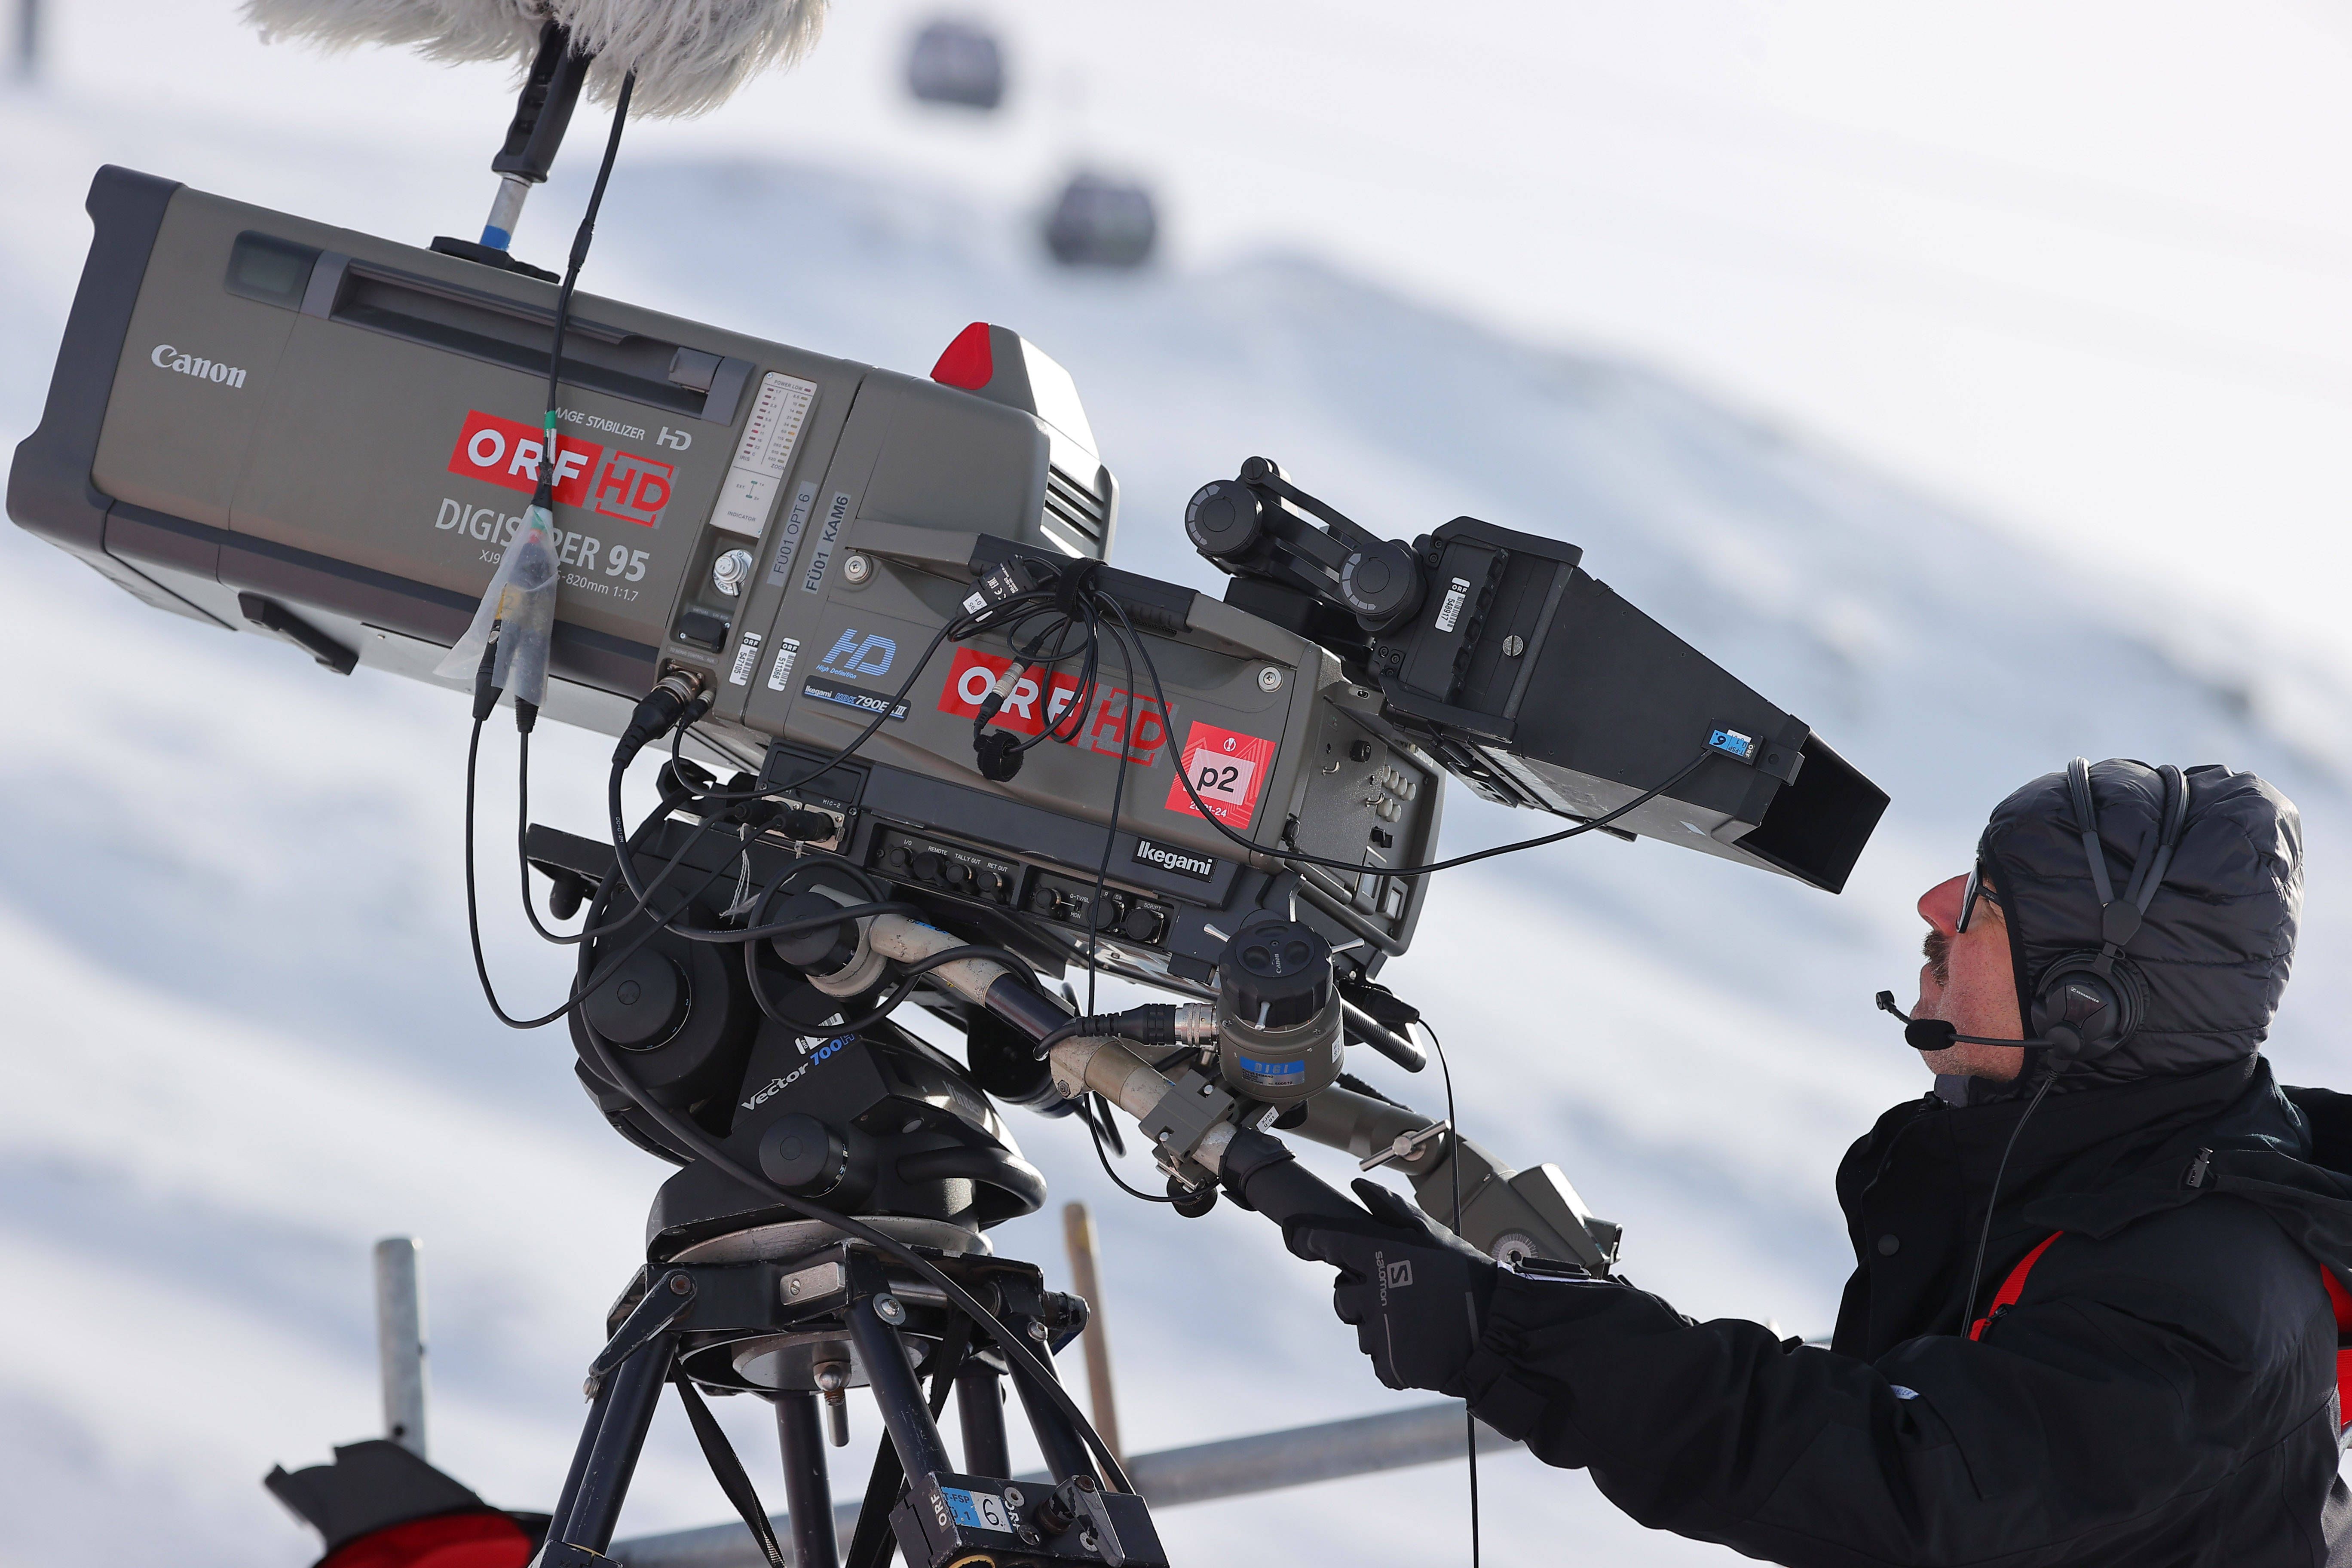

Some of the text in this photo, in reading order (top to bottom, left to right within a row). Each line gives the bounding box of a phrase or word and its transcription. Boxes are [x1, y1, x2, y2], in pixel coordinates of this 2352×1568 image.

[151, 344, 247, 388] Canon
[774, 380, 791, 388] POWER
[544, 407, 692, 451] MAGE STABILIZER HD
[467, 429, 671, 513] ORF HD
[727, 511, 756, 522] INDICATOR
[435, 498, 650, 582] DIGISPER 95
[774, 493, 810, 574] FÜ01 OPT 6
[806, 496, 848, 591] FÜ01 KAM6
[479, 549, 501, 565] XJ9
[613, 585, 639, 602] 1:1.7
[717, 581, 728, 591] LOCK
[1452, 584, 1468, 593] ORF
[968, 602, 978, 612] J95
[974, 598, 983, 607] -01
[1441, 598, 1455, 621] 548917
[744, 638, 759, 646] ORF
[782, 643, 797, 652] ORF
[822, 628, 896, 676] HD
[734, 652, 747, 674] 547105
[772, 657, 786, 679] 511368
[816, 665, 857, 679] High Definition
[805, 685, 832, 698] Ikegami
[958, 666, 1168, 751] ORF HD
[1745, 744, 1754, 758] ORF
[1197, 766, 1238, 793] p2
[823, 799, 841, 808] MIC-2
[928, 846, 948, 856] REMOTE
[955, 853, 970, 862] TALLY
[1137, 841, 1213, 876] Ikegami
[1070, 894, 1090, 903] Q-TV/GL
[1144, 902, 1161, 911] SCRIPT
[1254, 1063, 1289, 1074] DIGI
[741, 1062, 808, 1110] Vector
[1261, 1112, 1273, 1124] XJ95
[942, 1492, 970, 1504] T-FSP
[931, 1493, 947, 1526] ORF
